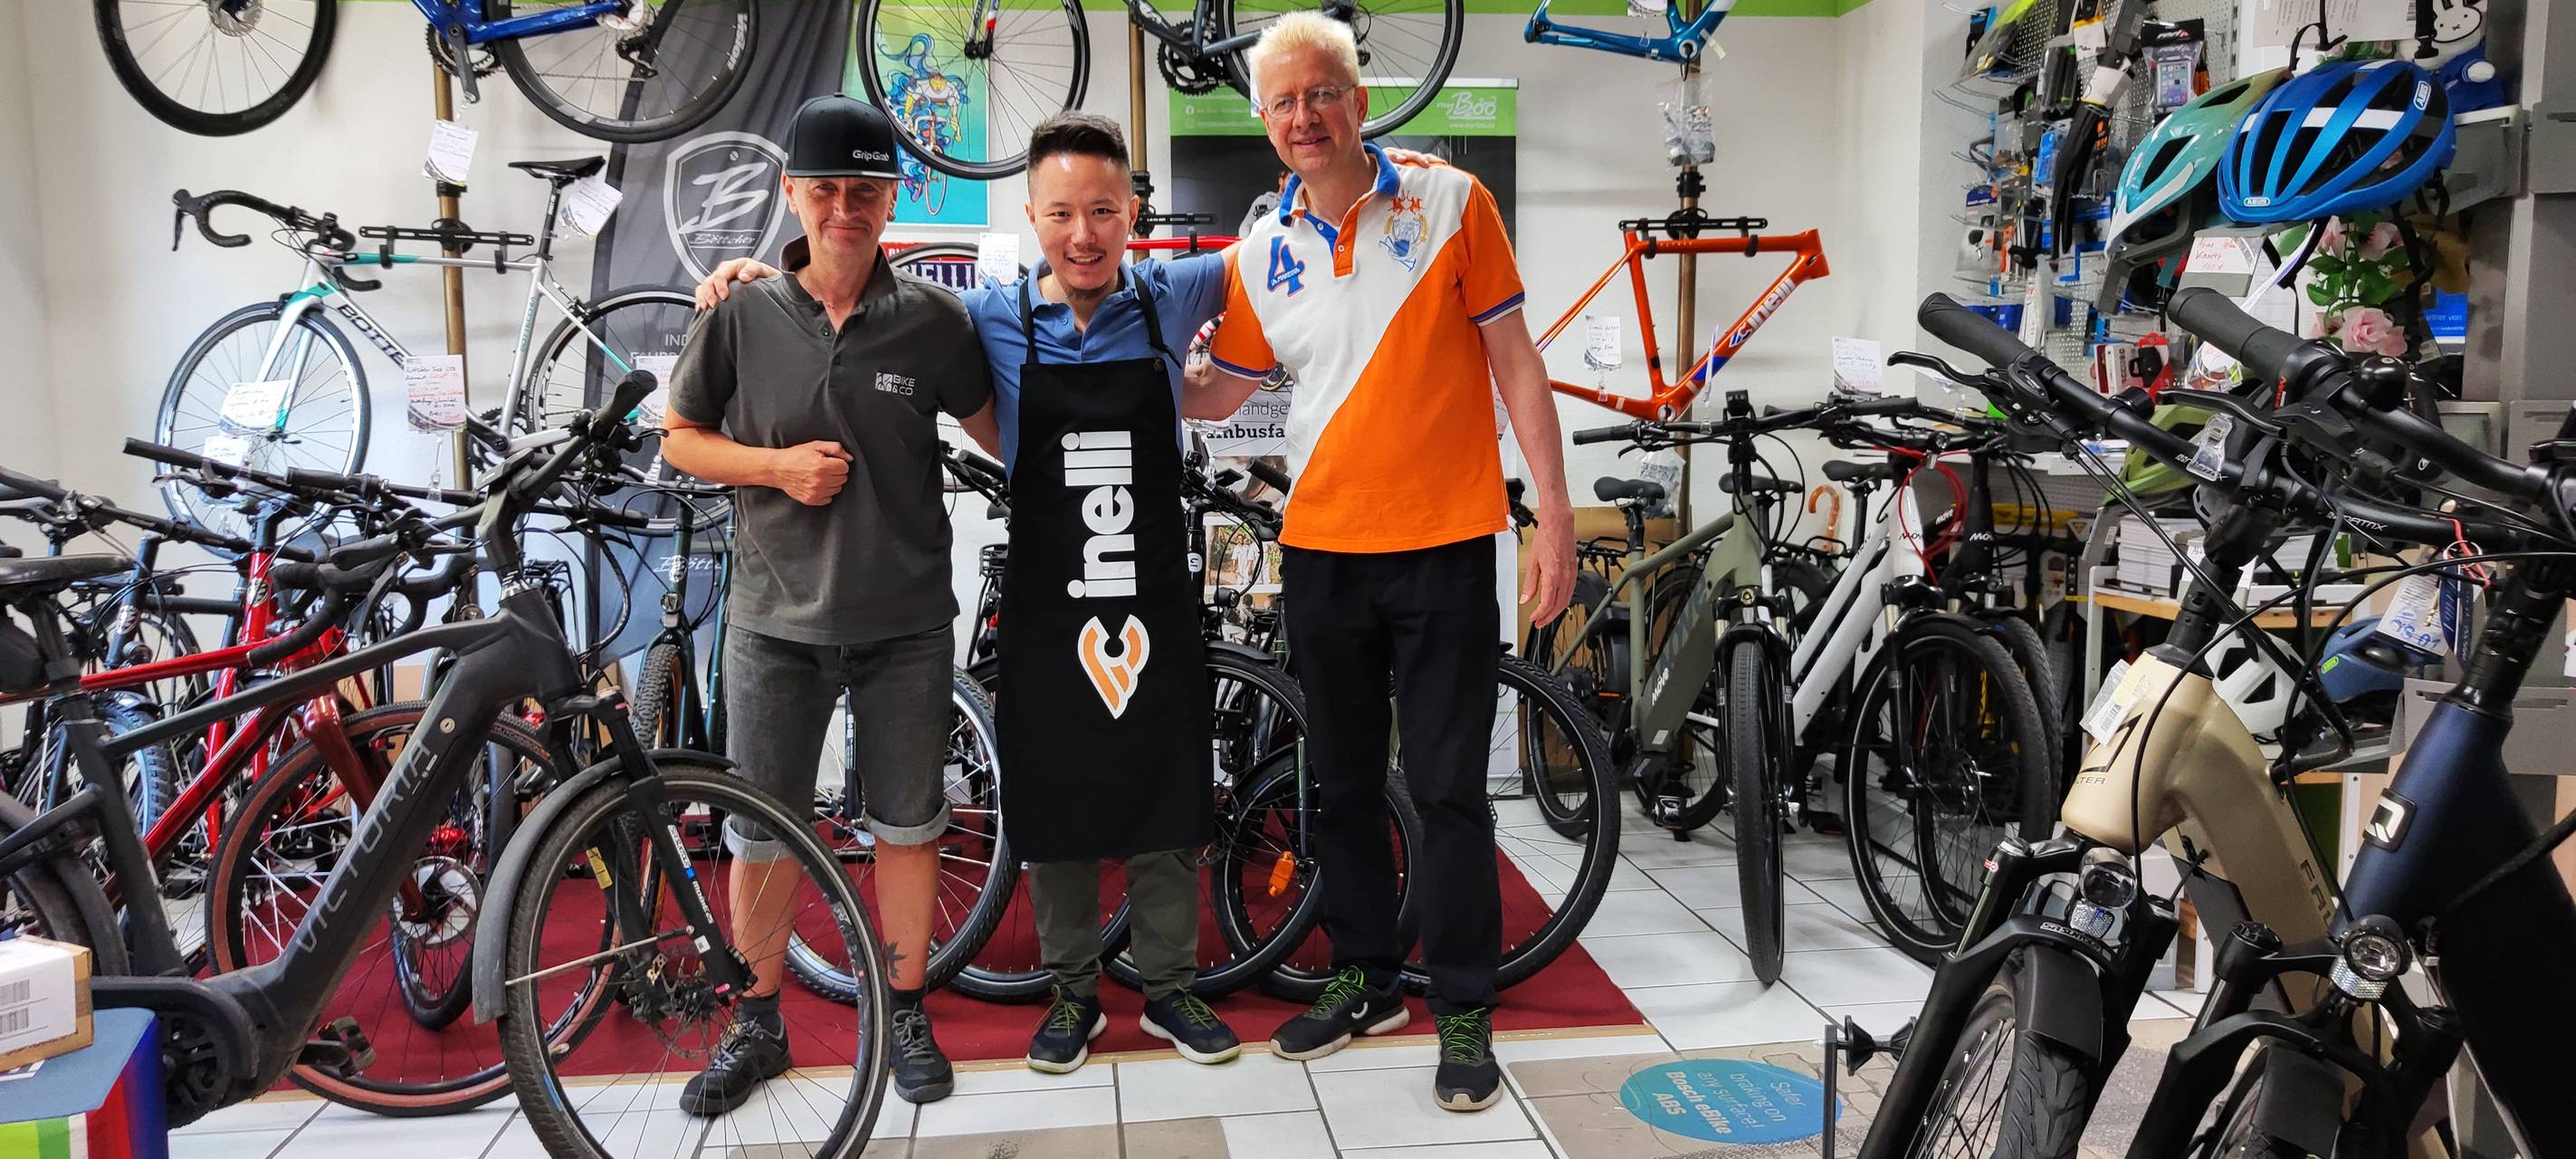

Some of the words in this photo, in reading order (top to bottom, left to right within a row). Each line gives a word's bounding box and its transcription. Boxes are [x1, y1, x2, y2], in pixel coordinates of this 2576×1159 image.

[893, 374, 915, 388] BIKE
[899, 386, 913, 396] CO
[298, 740, 430, 953] VICTORIA
[1652, 1092, 1687, 1116] ABS
[1665, 1071, 1703, 1104] Bosch
[1694, 1103, 1732, 1135] eBike
[1696, 1071, 1722, 1088] any
[1713, 1088, 1766, 1128] surface!
[1730, 1073, 1772, 1108] braking
[1764, 1107, 1787, 1123] on
[1770, 1081, 1806, 1106] Safer
